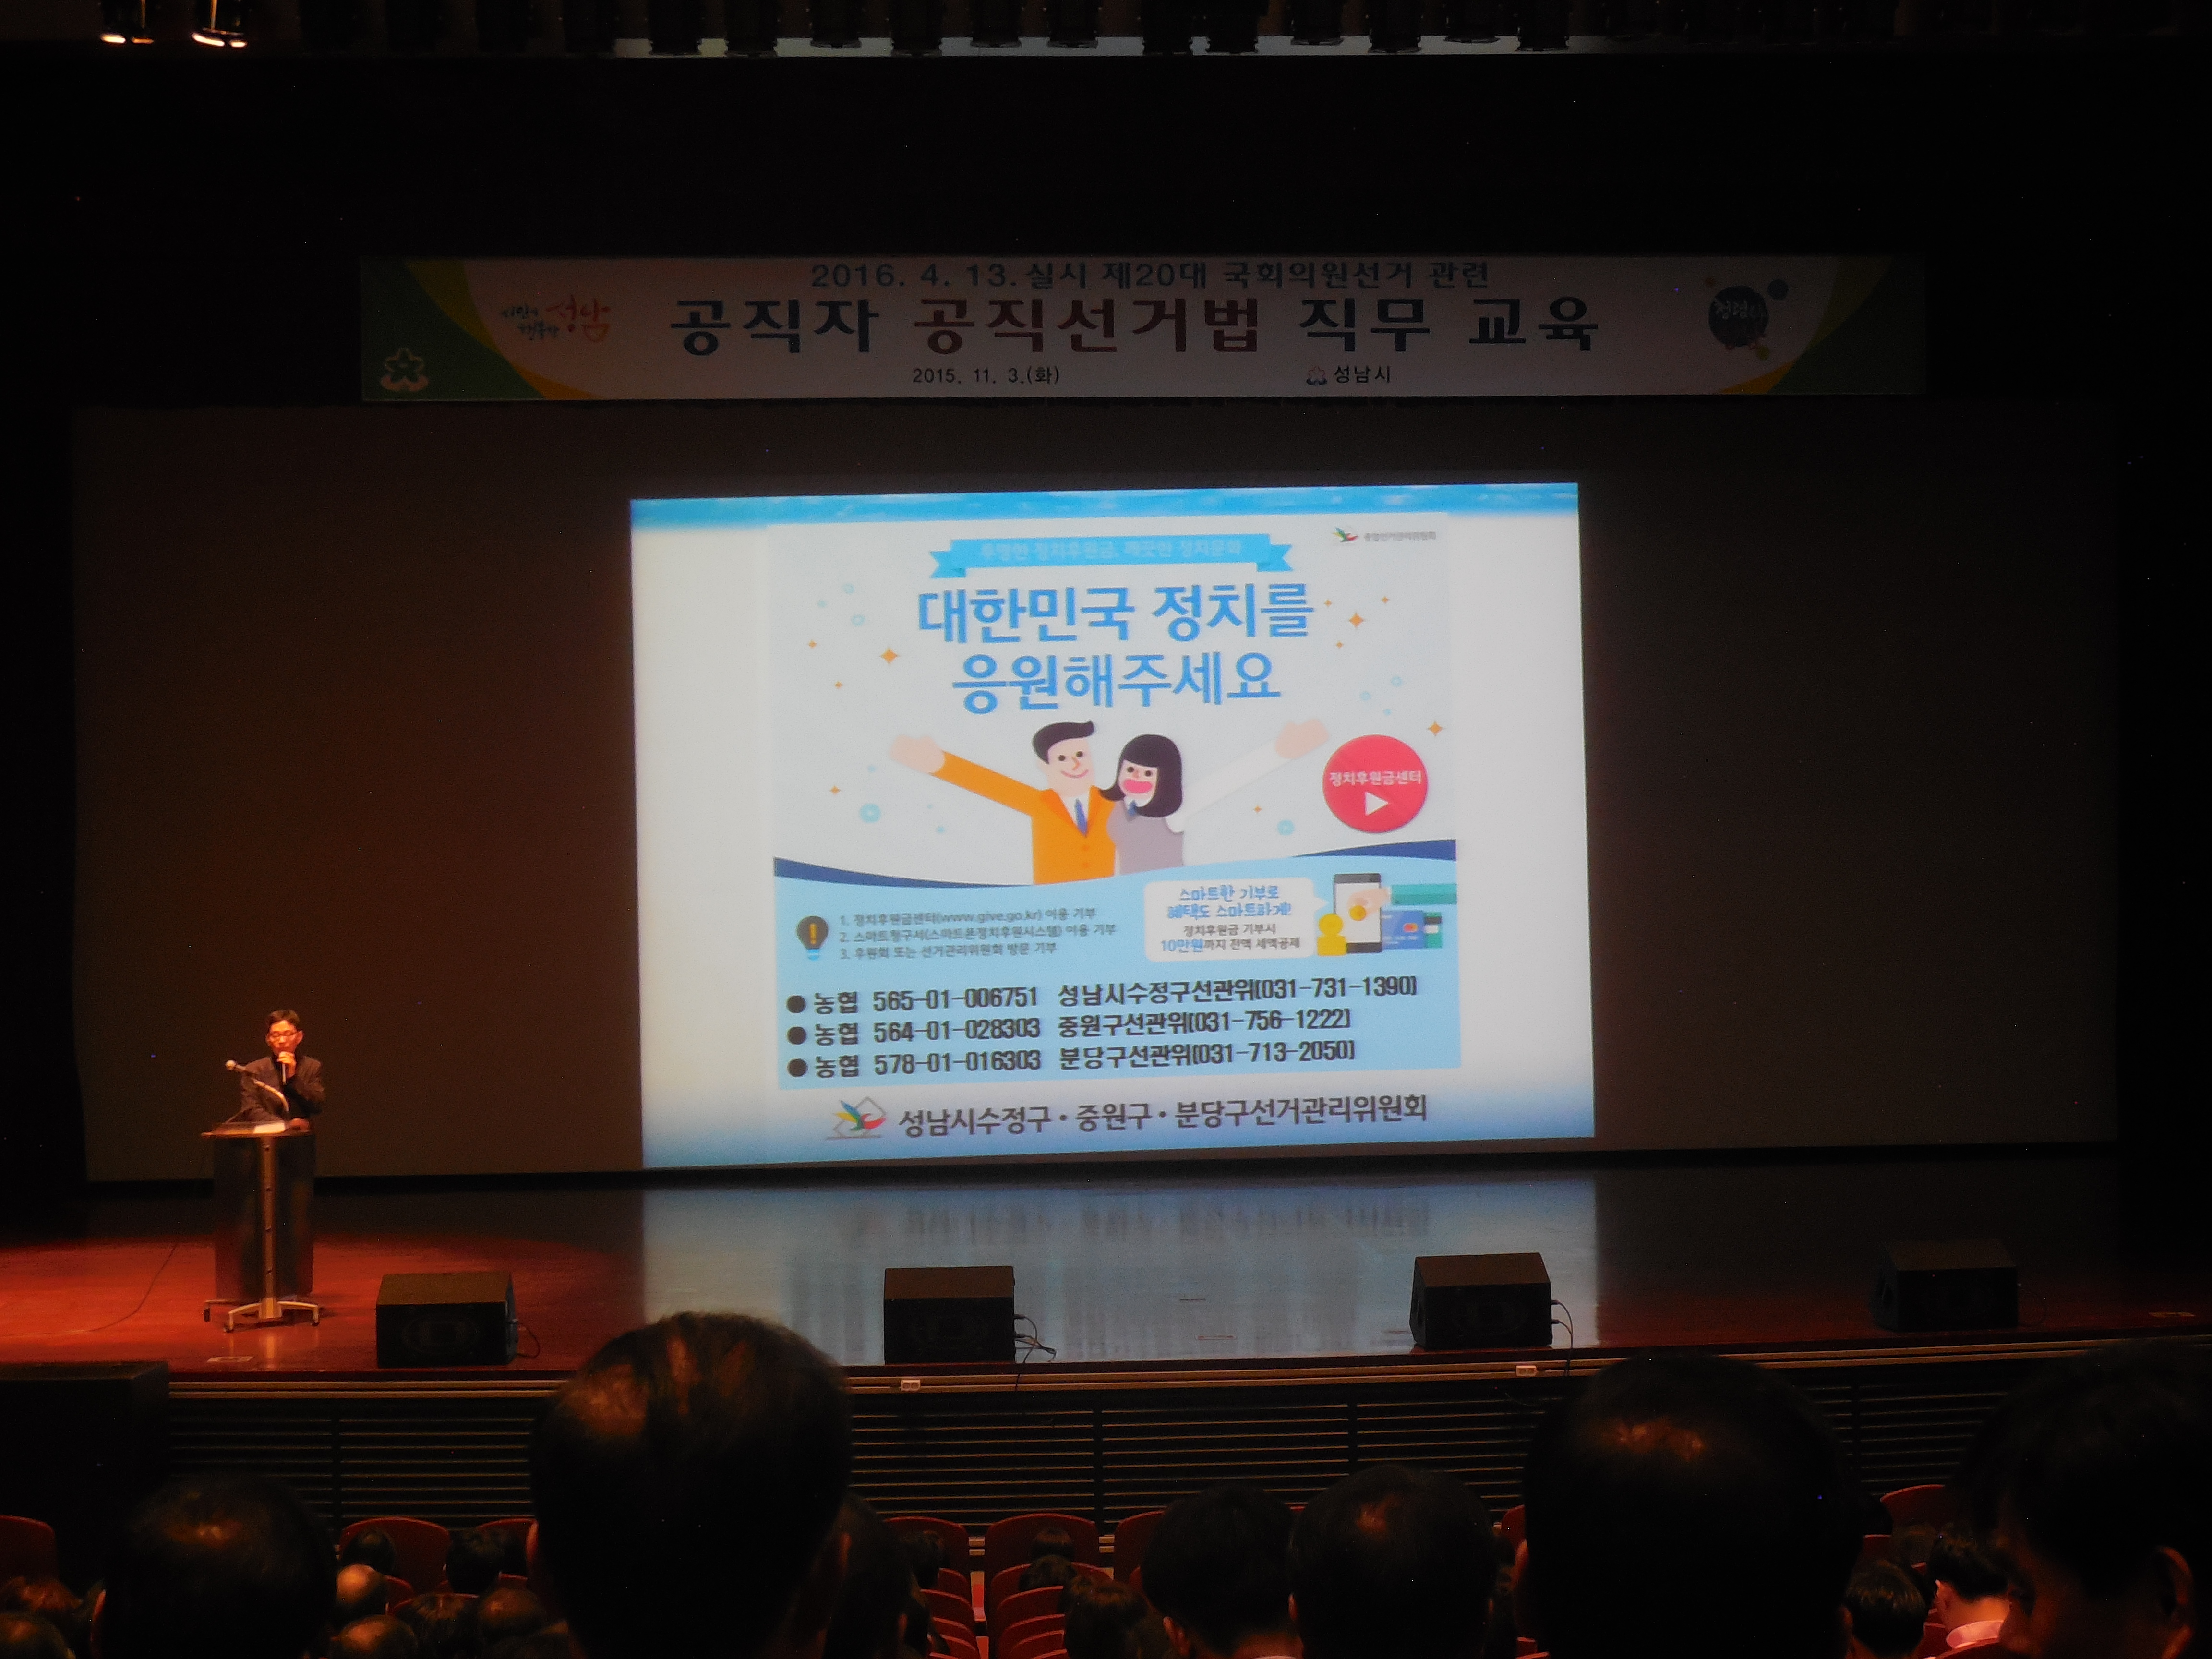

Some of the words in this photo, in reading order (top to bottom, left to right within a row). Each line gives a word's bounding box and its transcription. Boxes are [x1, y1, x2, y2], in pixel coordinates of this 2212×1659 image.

[812, 264, 904, 287] 2016.
[921, 264, 950, 287] 4.
[1103, 263, 1206, 289] 제20대
[1225, 262, 1411, 289] 국회의원선거
[1430, 262, 1489, 288] 관련
[670, 299, 879, 356] 공직자
[914, 299, 1258, 355] 공직선거법
[1299, 299, 1430, 353] 직무
[1468, 298, 1599, 352] 교육
[913, 368, 961, 384] 2015.
[974, 369, 996, 384] 11.
[1334, 365, 1390, 383] 성남시
[918, 586, 1135, 644] 대한민국
[1153, 582, 1314, 642] 정치를
[952, 651, 1281, 715] 응원해주세요
[1330, 770, 1421, 787] 정치후원금센터
[1180, 884, 1235, 902] 스마트한
[1240, 885, 1279, 901] 기부로
[1045, 908, 1070, 921] 이용
[1073, 907, 1096, 919] 기부
[1066, 923, 1090, 937] 이용
[1094, 923, 1117, 936] 기부
[1184, 924, 1238, 937] 정치후원금
[1243, 923, 1276, 935] 기부시
[894, 946, 917, 959] 또는
[1007, 942, 1030, 956] 방문
[1034, 942, 1057, 954] 기부
[1230, 938, 1252, 950] 전액
[1256, 937, 1300, 950] 세액공제
[815, 991, 858, 1015] 농협
[873, 986, 1038, 1012] 565-01-006751
[815, 1022, 859, 1046] 농협
[874, 1018, 1041, 1043] 564-01-028303
[816, 1055, 859, 1079] 농협
[875, 1049, 1041, 1076] 578-01-016303
